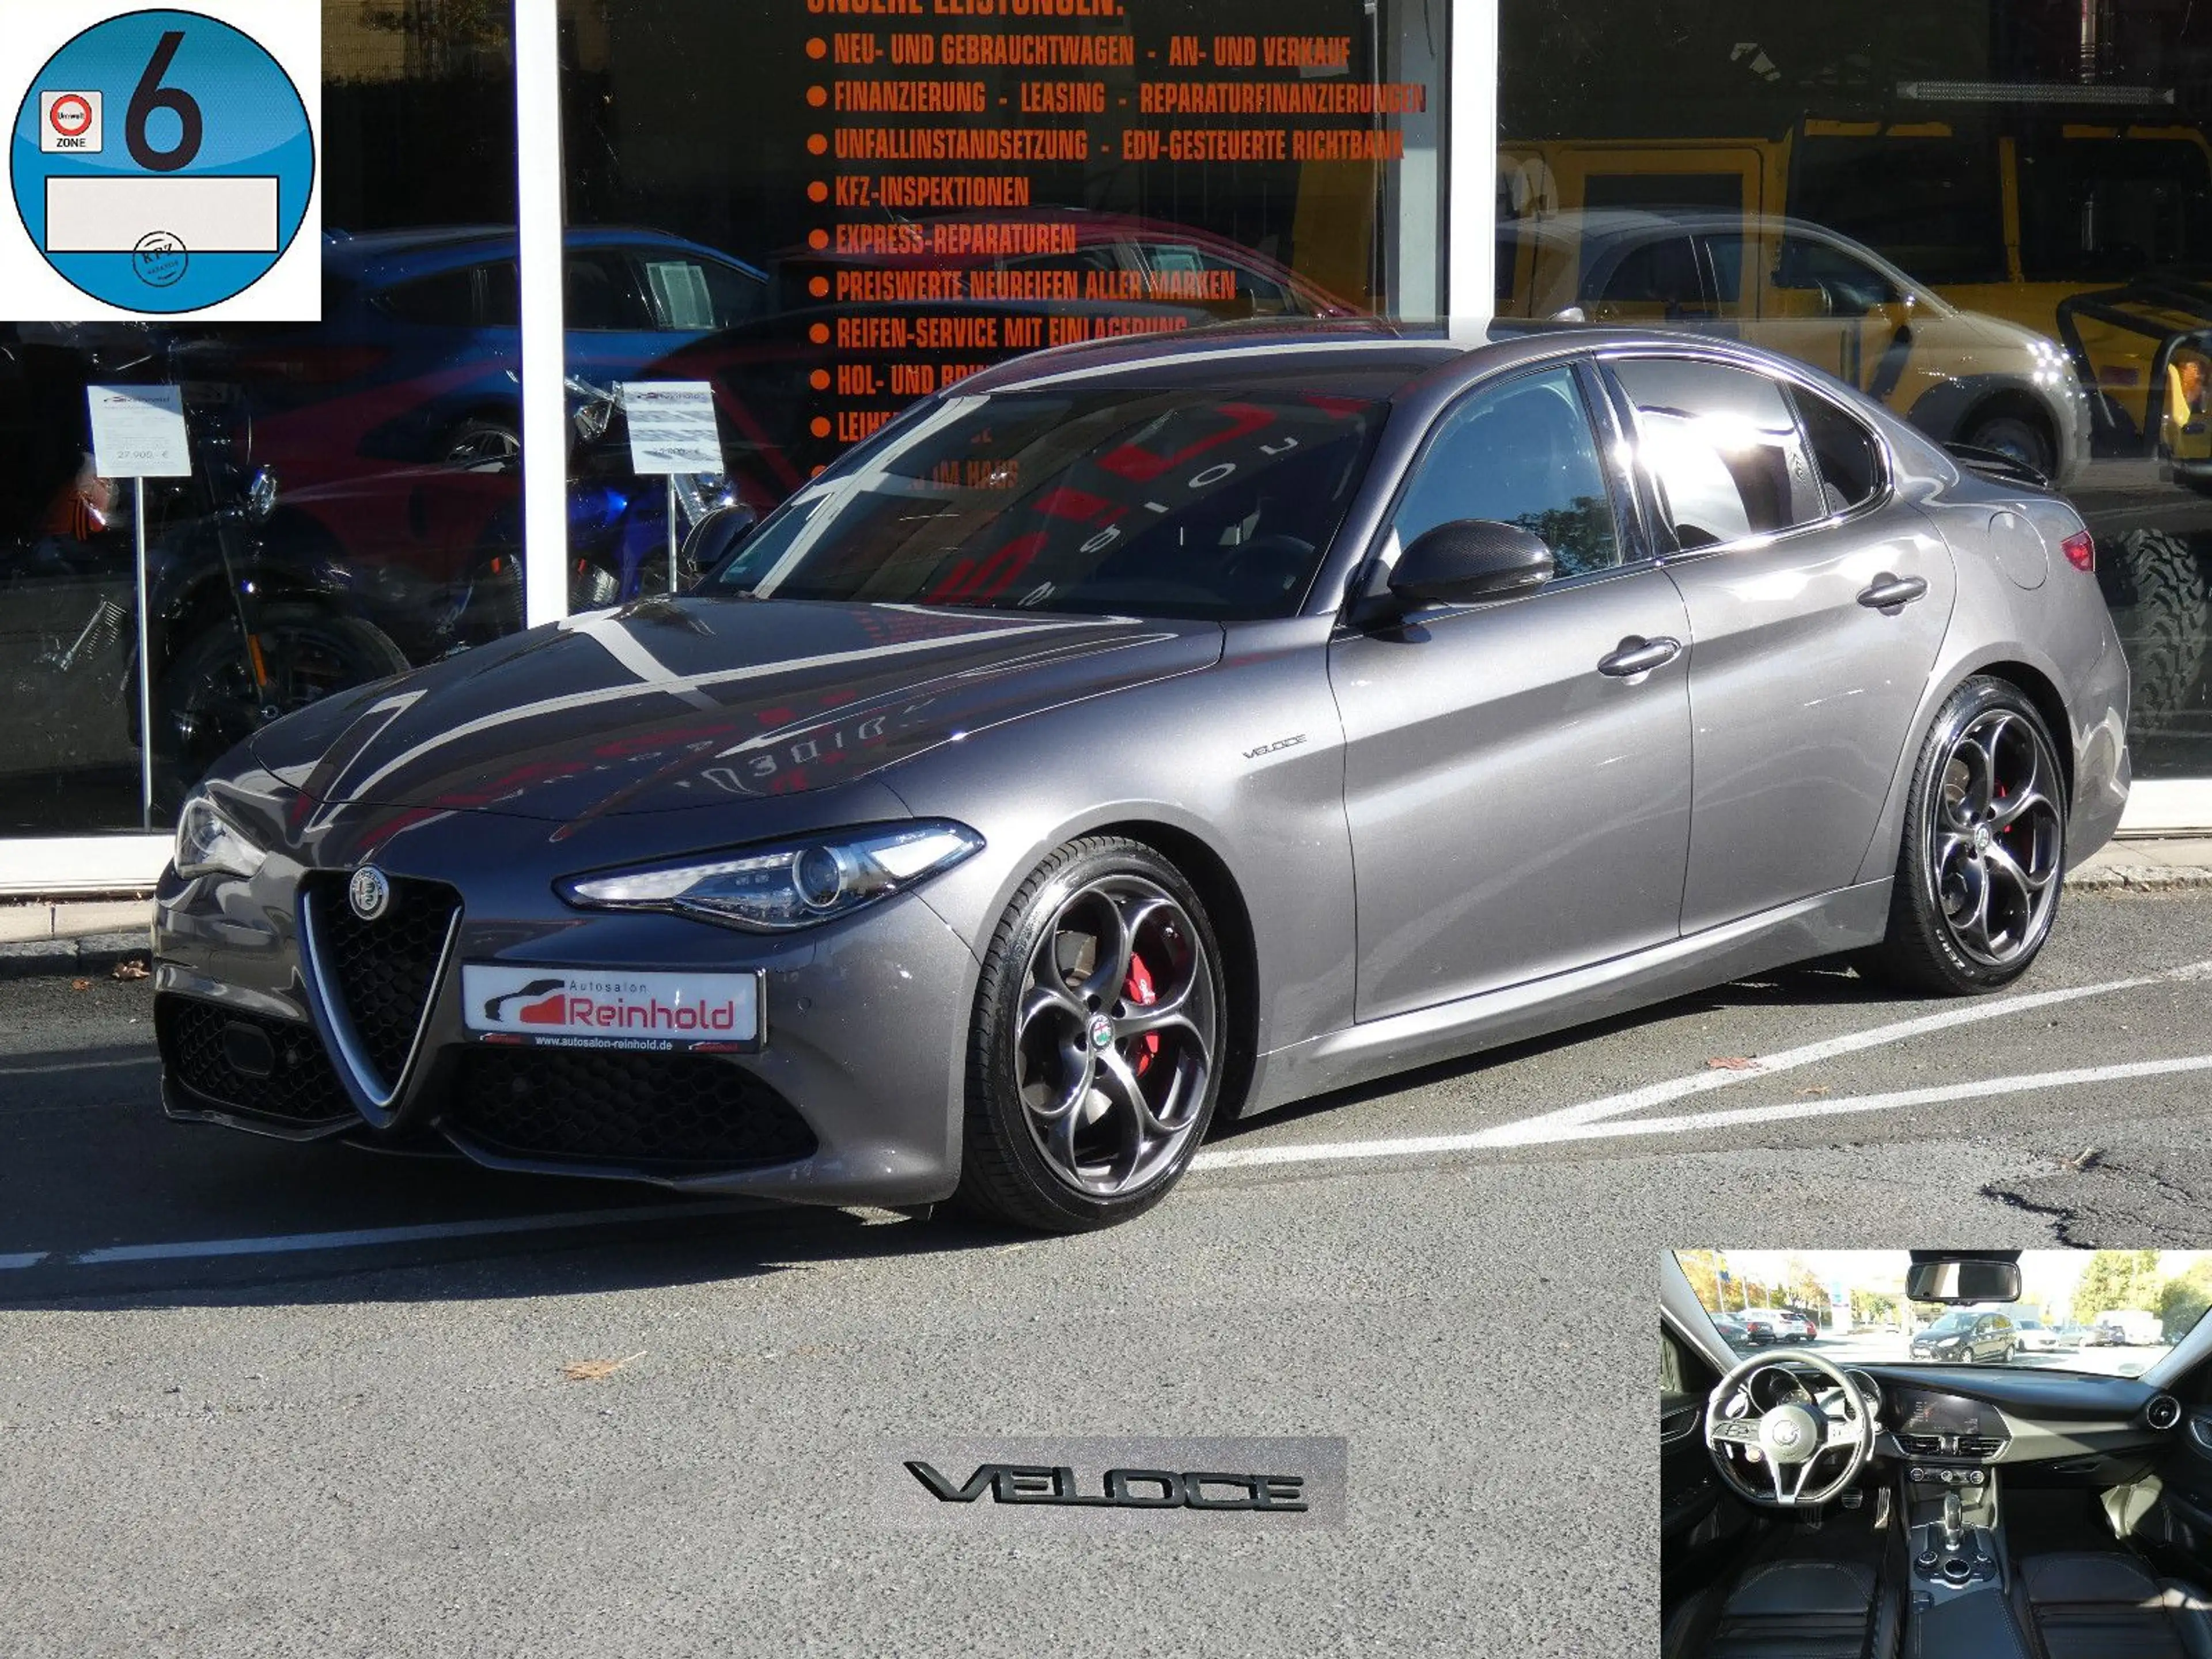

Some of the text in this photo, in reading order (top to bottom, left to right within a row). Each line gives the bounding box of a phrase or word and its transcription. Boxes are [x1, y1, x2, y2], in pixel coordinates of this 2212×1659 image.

[835, 33, 883, 65] NEU-
[892, 35, 934, 65] UND
[941, 35, 1134, 66] GEBRAUCHTWAGEN
[1169, 36, 1207, 66] AN-
[1214, 36, 1256, 66] UND
[1264, 37, 1350, 66] VERKAUF
[835, 81, 986, 112] FINANZIERUNG
[1021, 82, 1105, 112] LEASING
[1140, 82, 1426, 113] REPARATURFINANZIERUNGEN
[835, 128, 1088, 160] UNFALLINSTANDSETZUNG
[1123, 130, 1285, 160] EDV-GESTEUERTE
[1292, 130, 1405, 160] RICHTBANK
[836, 176, 1029, 206] KFZ-INSPEKTIONEN
[836, 224, 1076, 253] EXPRESS-REPARATUREN
[836, 270, 1236, 301] PREISWERTE NEUREIFEN ALLER MARKEN
[837, 317, 997, 348] REIFEN-SERVICE
[1005, 317, 1042, 347] MIT
[838, 365, 884, 395] HOL-
[891, 365, 934, 395] UND
[1242, 733, 1307, 758] VELOCE
[569, 980, 647, 993] Autosalon
[569, 998, 734, 1030] Reinhold
[535, 1036, 673, 1050] www.autosalon-reinhold.de
